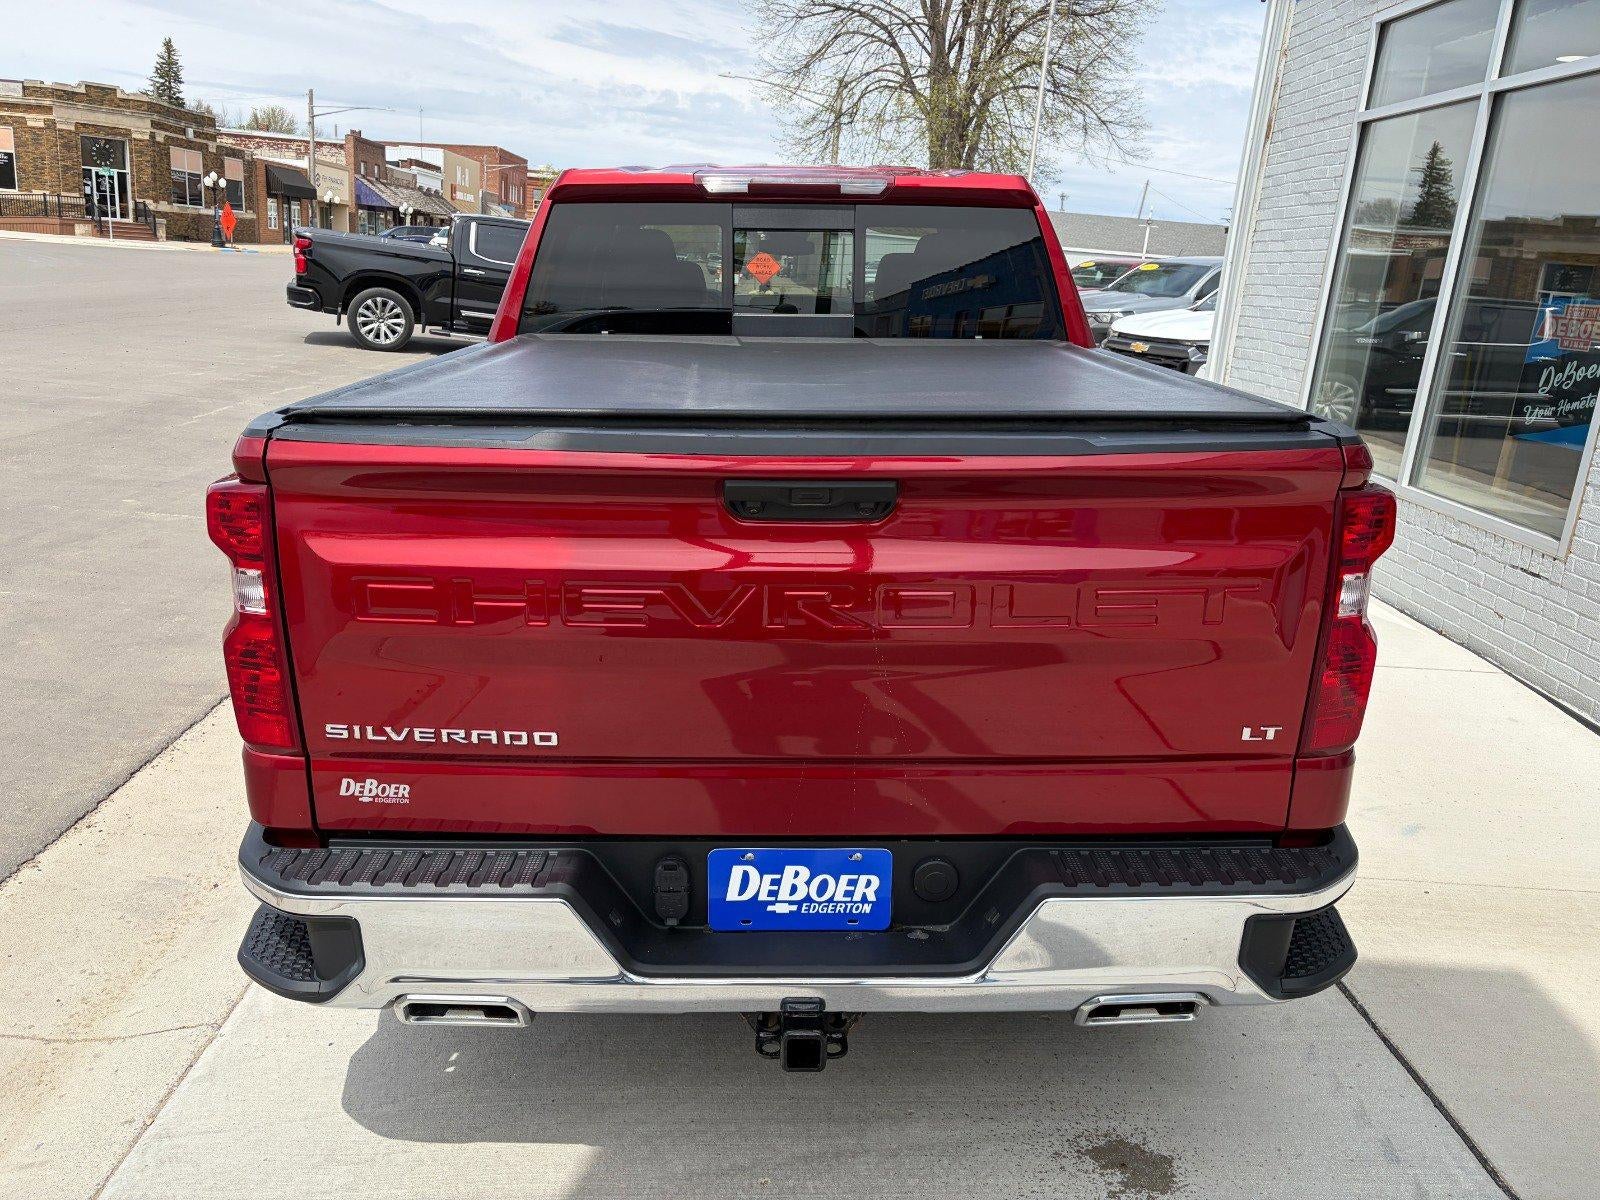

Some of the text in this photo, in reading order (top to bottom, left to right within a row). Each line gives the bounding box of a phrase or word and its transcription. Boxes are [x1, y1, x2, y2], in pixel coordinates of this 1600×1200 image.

[1523, 405, 1556, 426] Your
[350, 576, 1262, 629] CHEVROLET
[325, 723, 559, 747] SILVERADO
[1241, 726, 1283, 741] LT
[801, 902, 872, 914] EDGERTON
